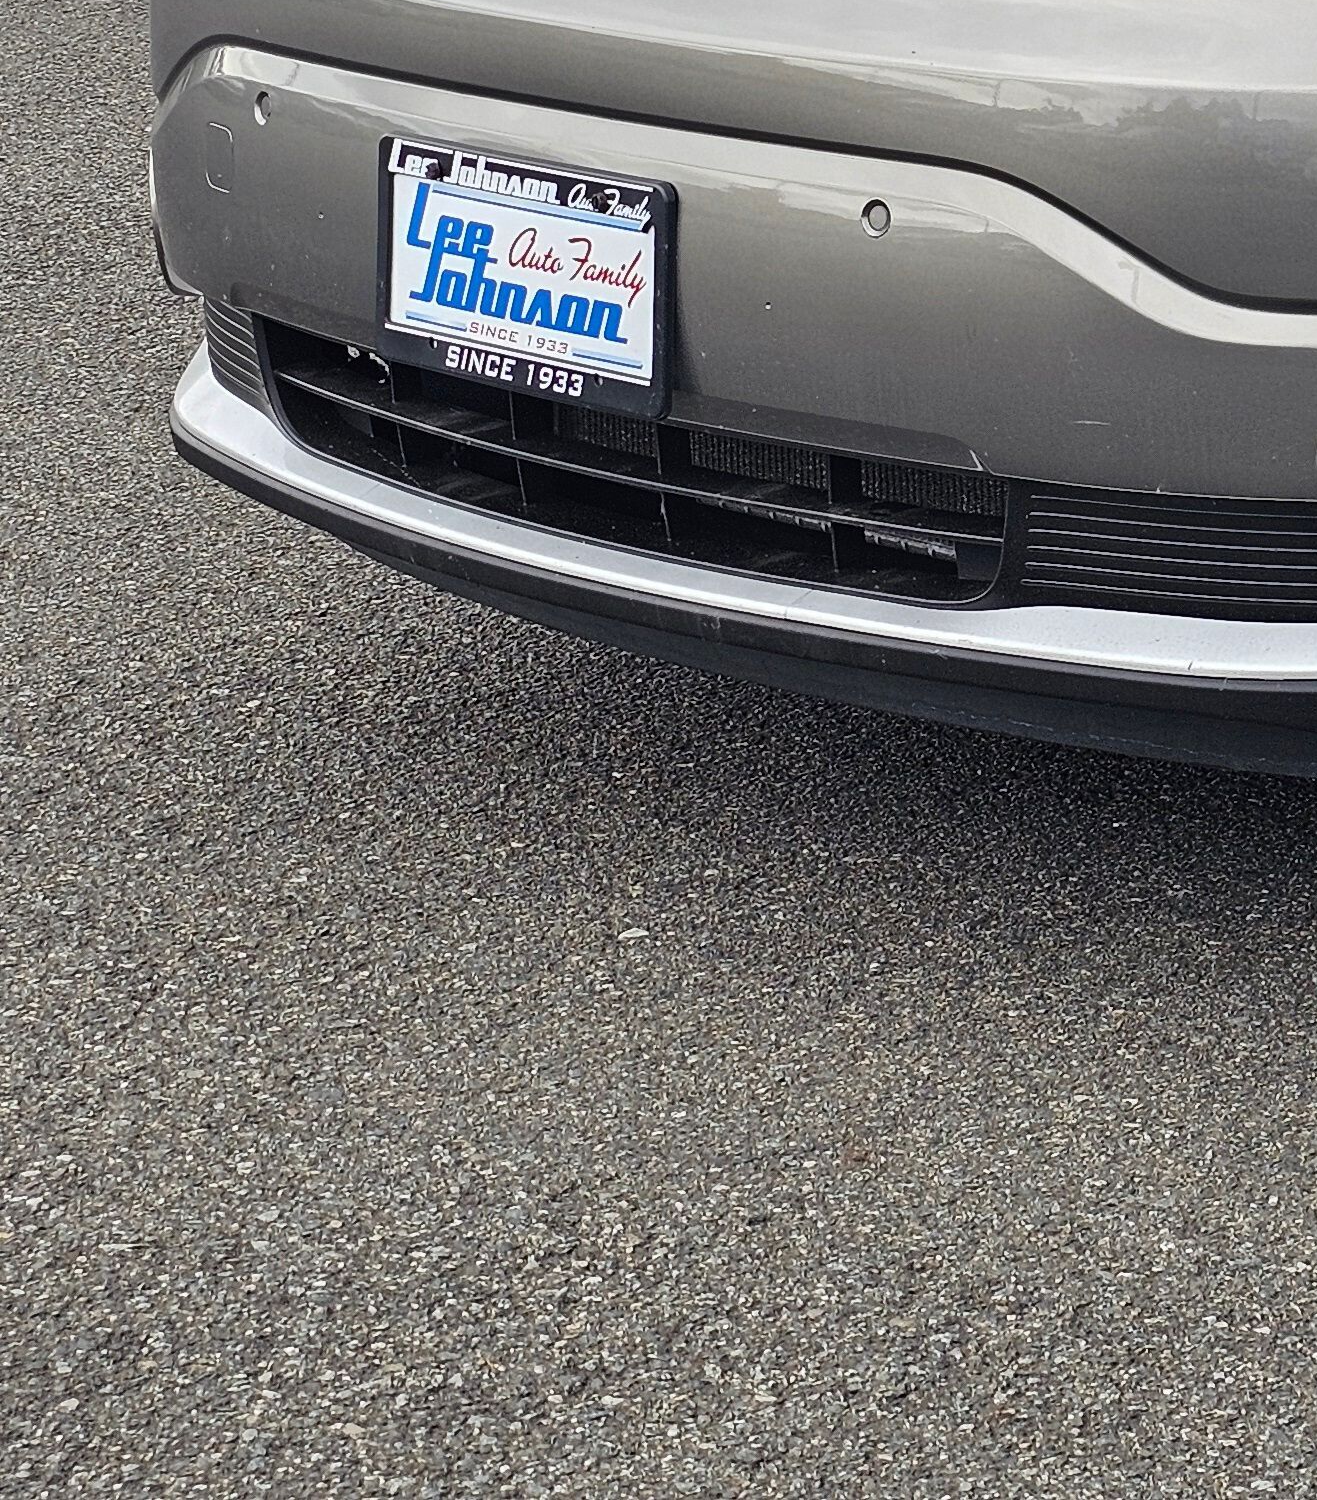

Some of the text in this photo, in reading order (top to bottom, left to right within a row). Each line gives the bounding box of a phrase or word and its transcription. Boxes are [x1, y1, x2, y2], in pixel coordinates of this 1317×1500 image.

[442, 151, 560, 204] Johnson
[603, 188, 652, 231] Family
[406, 182, 647, 308] Lee Auto Family
[409, 245, 628, 344] Johnson
[445, 346, 584, 398] SINCE 1933
[469, 321, 569, 354] SINCE 1933
